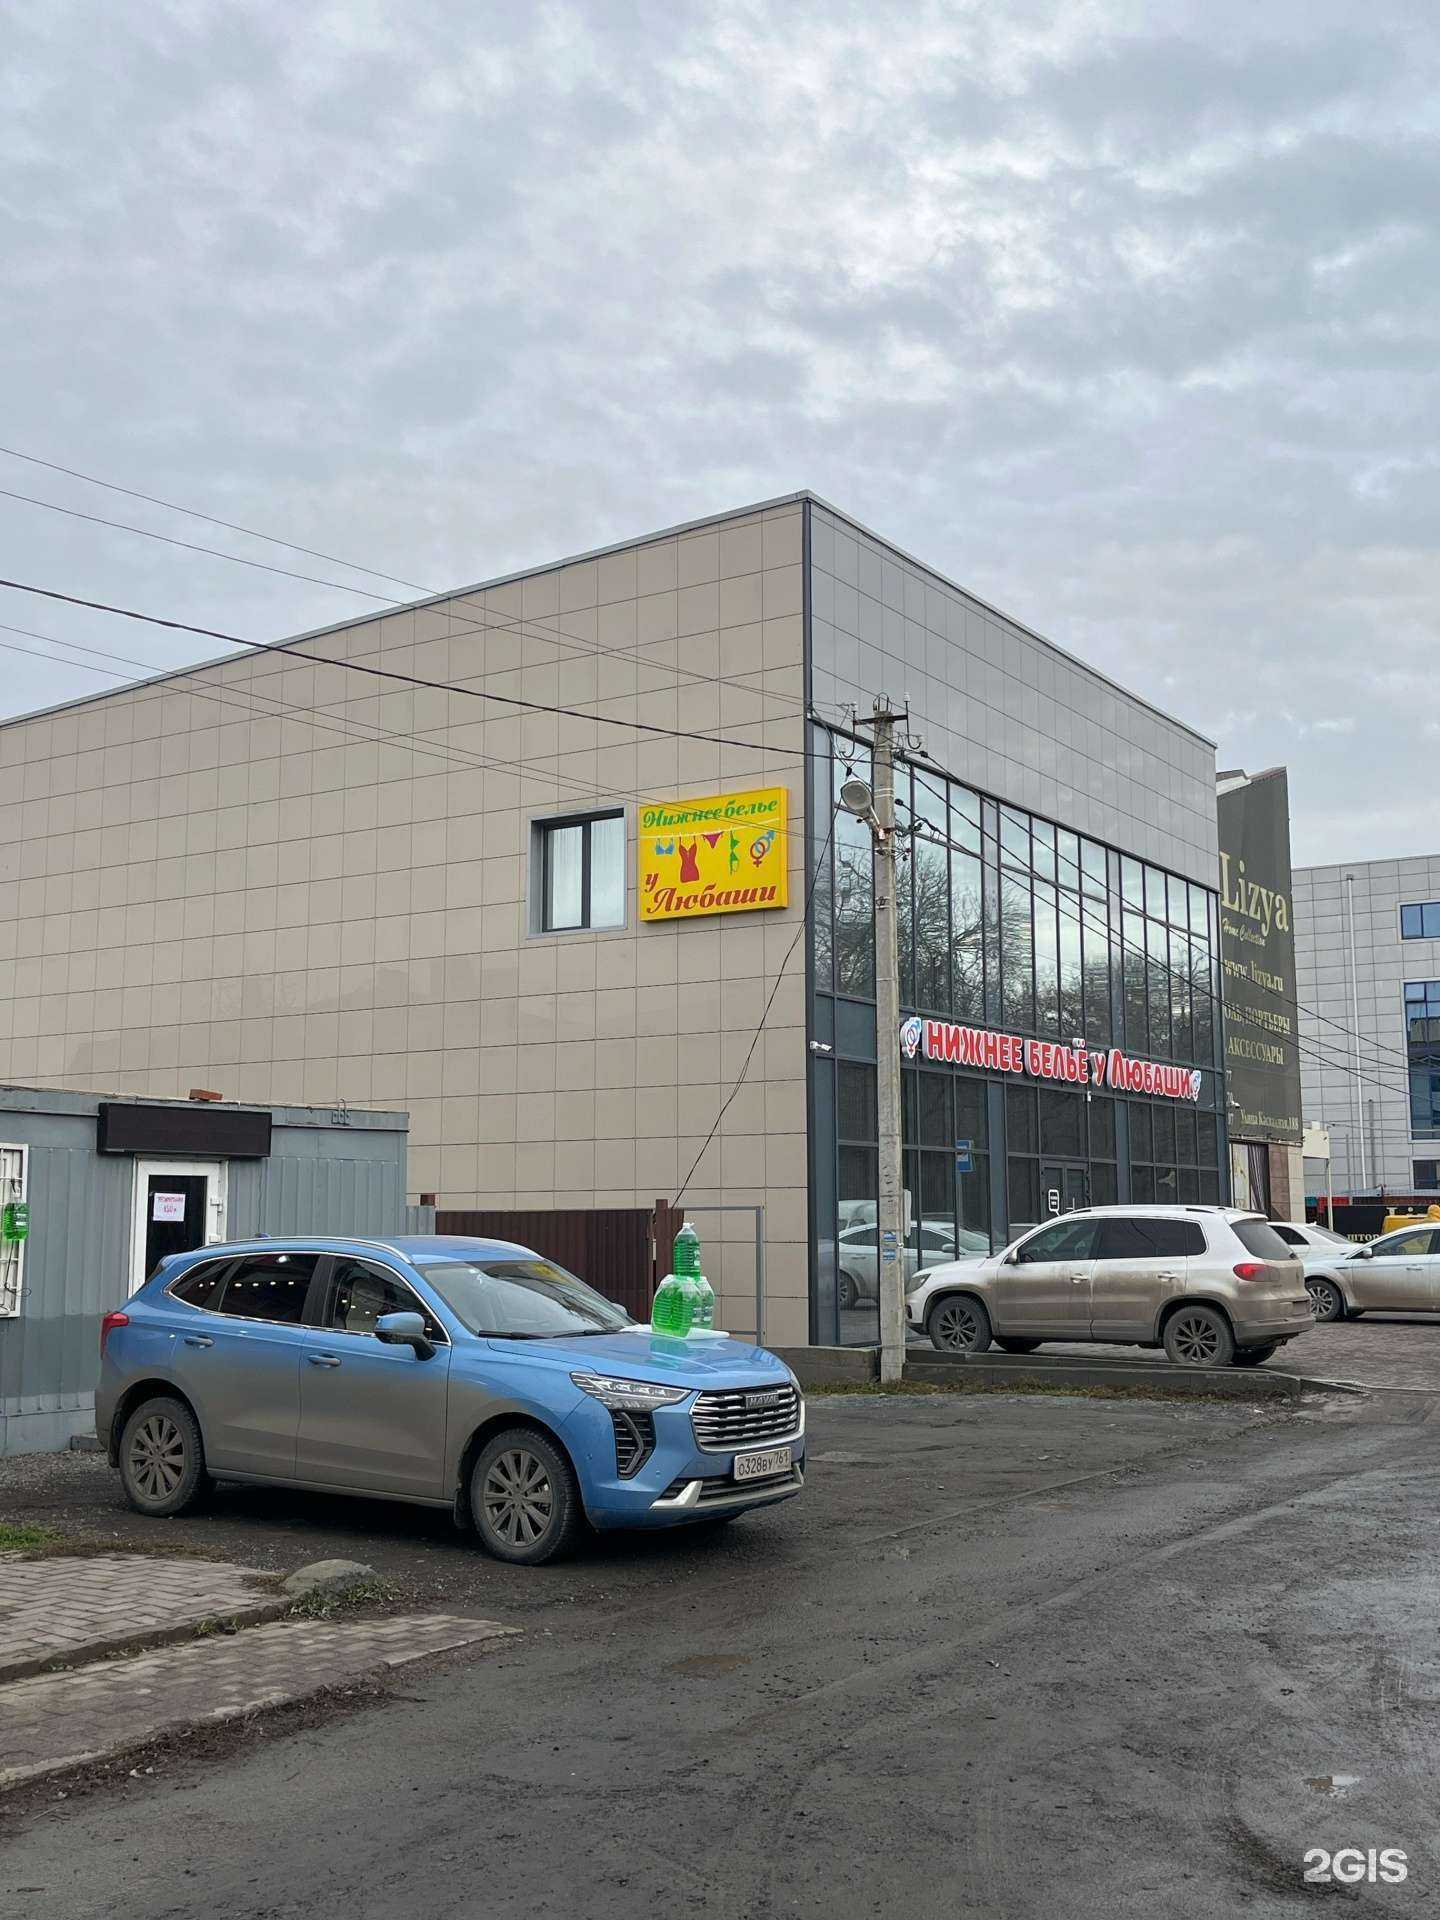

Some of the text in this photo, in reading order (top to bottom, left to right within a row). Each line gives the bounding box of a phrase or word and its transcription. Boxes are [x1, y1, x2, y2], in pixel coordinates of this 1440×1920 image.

[643, 799, 778, 829] Нижнее белье
[646, 883, 778, 914] Любаши
[1219, 850, 1290, 937] Lizya
[923, 1020, 1023, 1073] НИЖНЕЕ
[1227, 1036, 1285, 1065] АКСЕССУАРЫ
